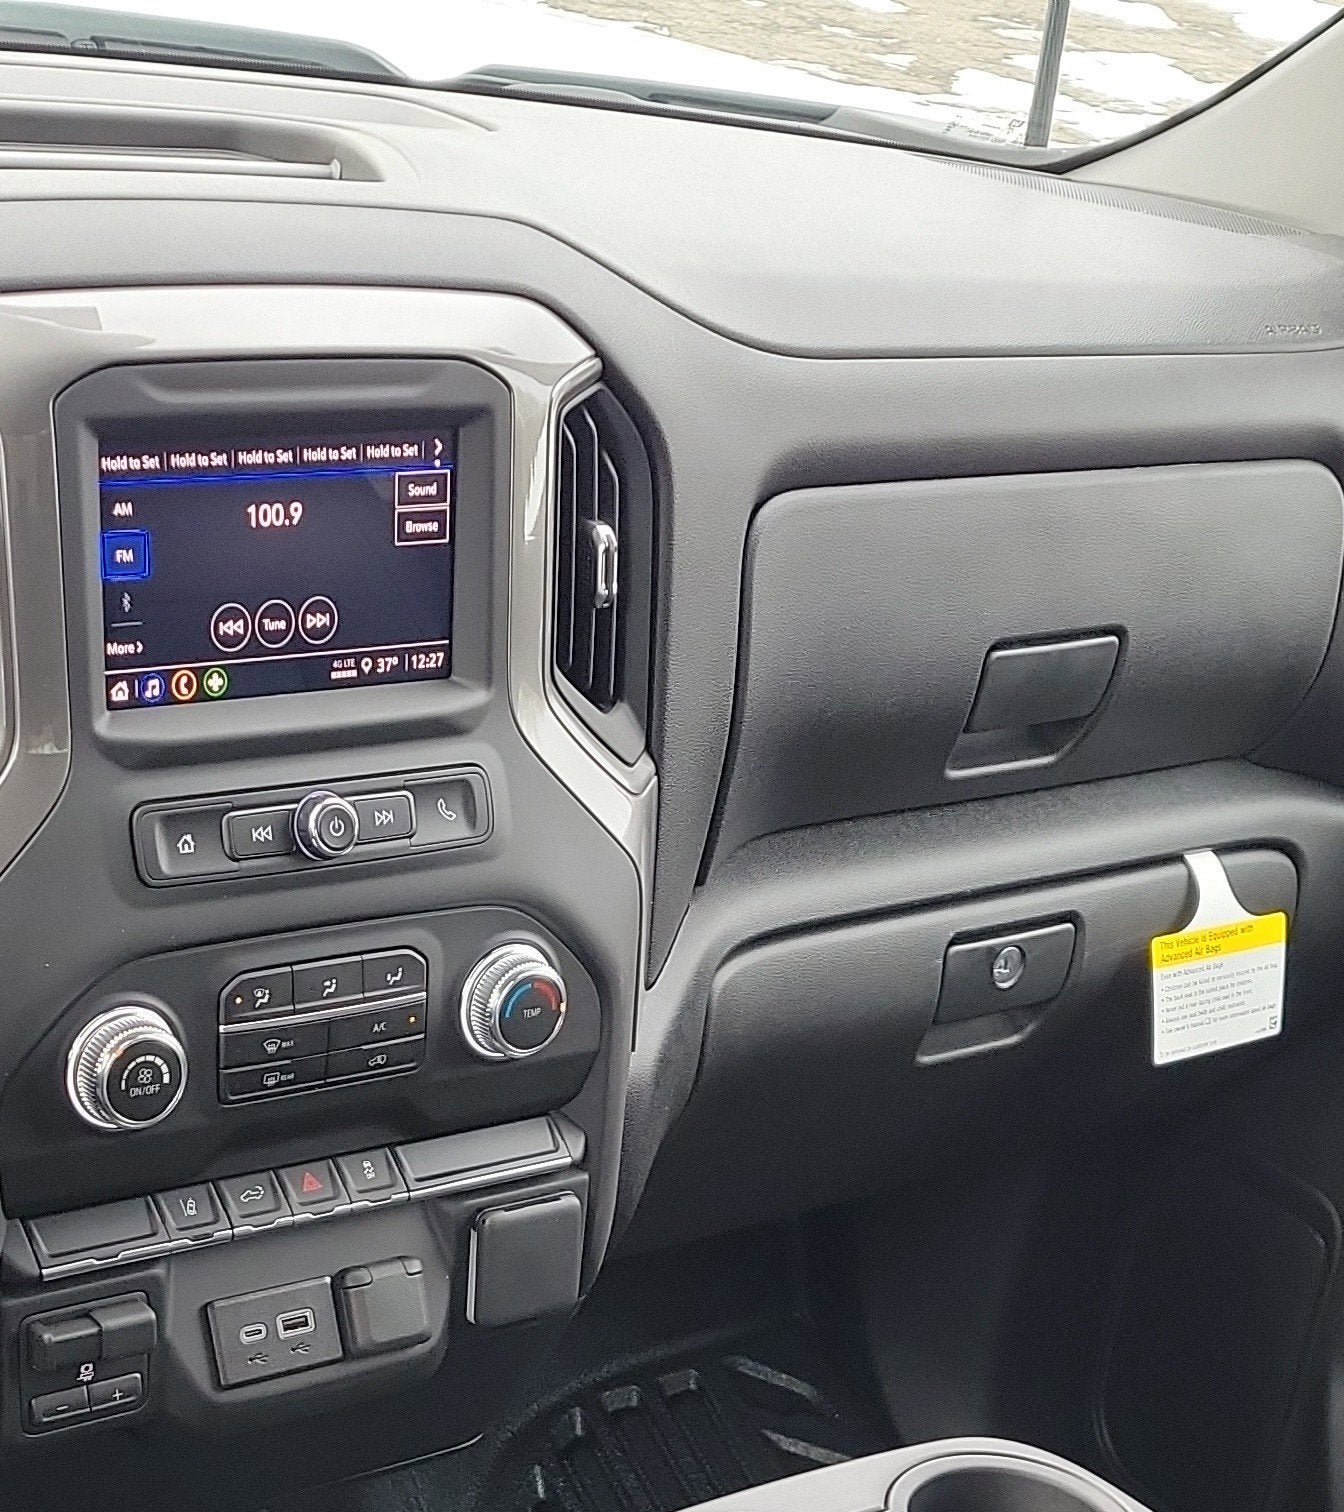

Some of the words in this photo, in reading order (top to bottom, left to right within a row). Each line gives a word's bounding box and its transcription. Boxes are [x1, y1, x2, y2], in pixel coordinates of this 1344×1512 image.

[238, 449, 262, 465] Hold
[264, 450, 275, 464] to
[276, 449, 293, 464] Set
[303, 448, 327, 462] Hold
[329, 448, 339, 461] to
[340, 446, 356, 460] Set
[366, 444, 389, 459] Hold
[391, 444, 401, 458] to
[402, 443, 419, 457] Set
[101, 455, 127, 472] Hold
[129, 456, 140, 470] to
[142, 455, 161, 469] Set
[171, 452, 196, 468] Hold
[198, 453, 209, 466] to
[210, 452, 228, 466] Set
[408, 482, 437, 497] Sound
[113, 501, 133, 516] AM
[247, 501, 303, 529] 100.9
[406, 520, 439, 534] Browse
[115, 548, 134, 564] FM
[263, 618, 287, 631] Tune
[106, 642, 135, 656] More
[344, 658, 355, 668] LTE
[411, 652, 445, 670] 12:27
[523, 1007, 541, 1019] TEMP
[372, 1021, 388, 1033] A/C
[129, 1083, 161, 1098] ON/OFF
